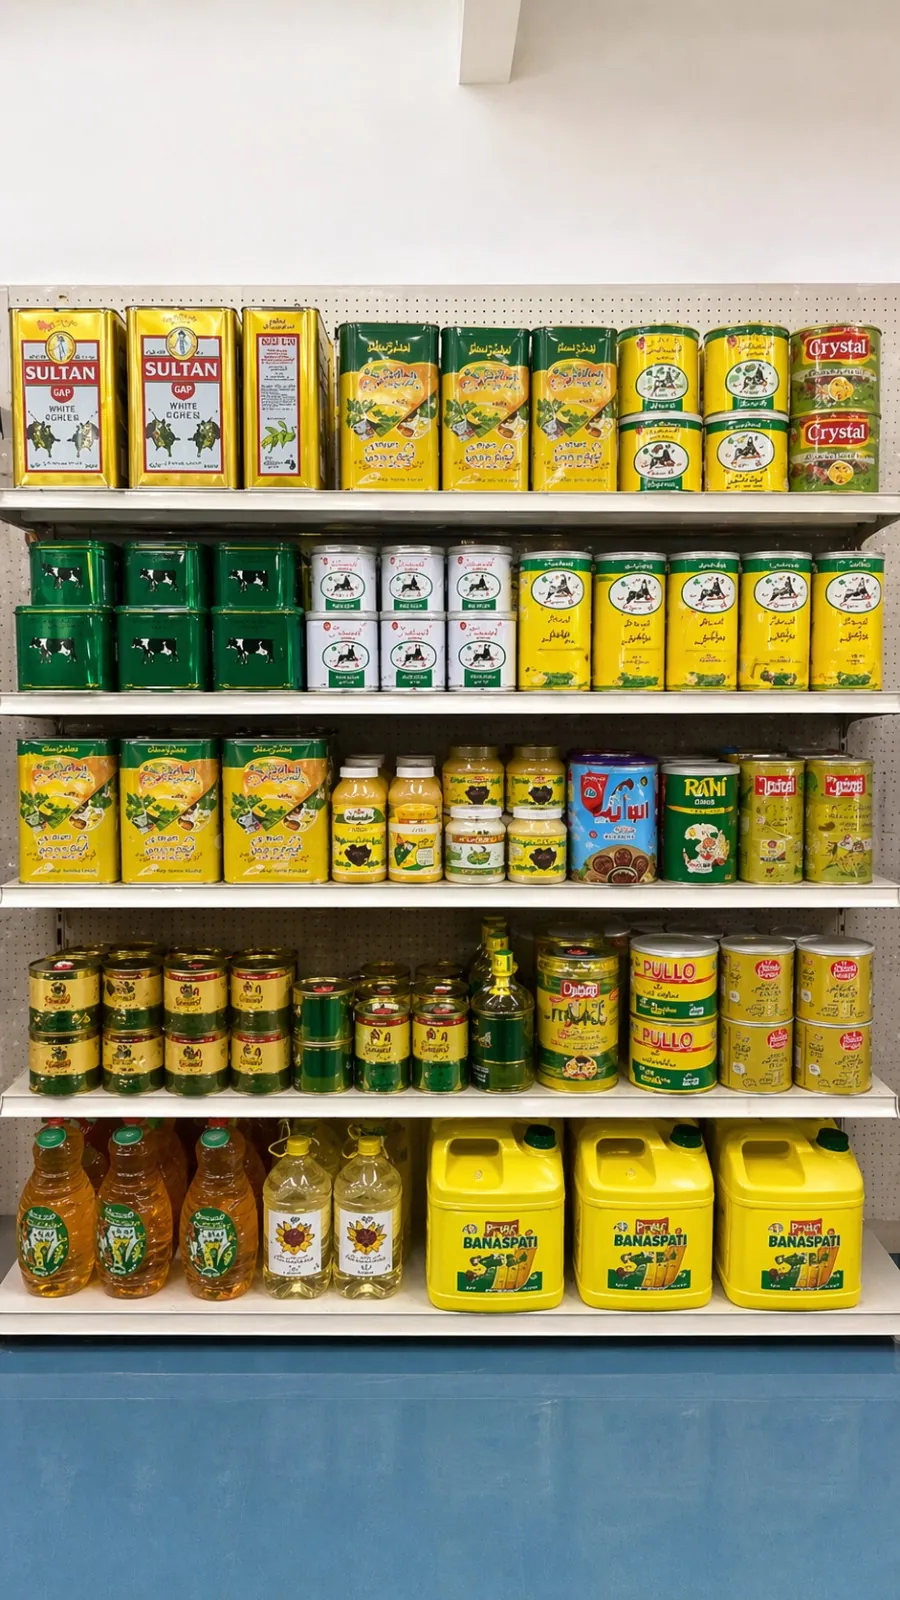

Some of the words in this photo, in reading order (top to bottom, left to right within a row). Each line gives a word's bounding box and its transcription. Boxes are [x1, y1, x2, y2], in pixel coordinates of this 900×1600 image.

[809, 339, 867, 358] Crystal
[25, 366, 96, 381] SULTAN
[145, 362, 218, 377] SULTAN
[53, 388, 71, 397] GAP
[174, 385, 192, 394] GAP
[49, 405, 76, 413] WHITE
[169, 402, 198, 410] WHITE
[807, 423, 866, 443] Crystal
[643, 960, 695, 980] PULLO
[642, 1027, 693, 1048] PULLO
[463, 1236, 537, 1249] BANASPATI
[614, 1234, 687, 1246] BANASPATI
[768, 1235, 840, 1247] BANASPATI
